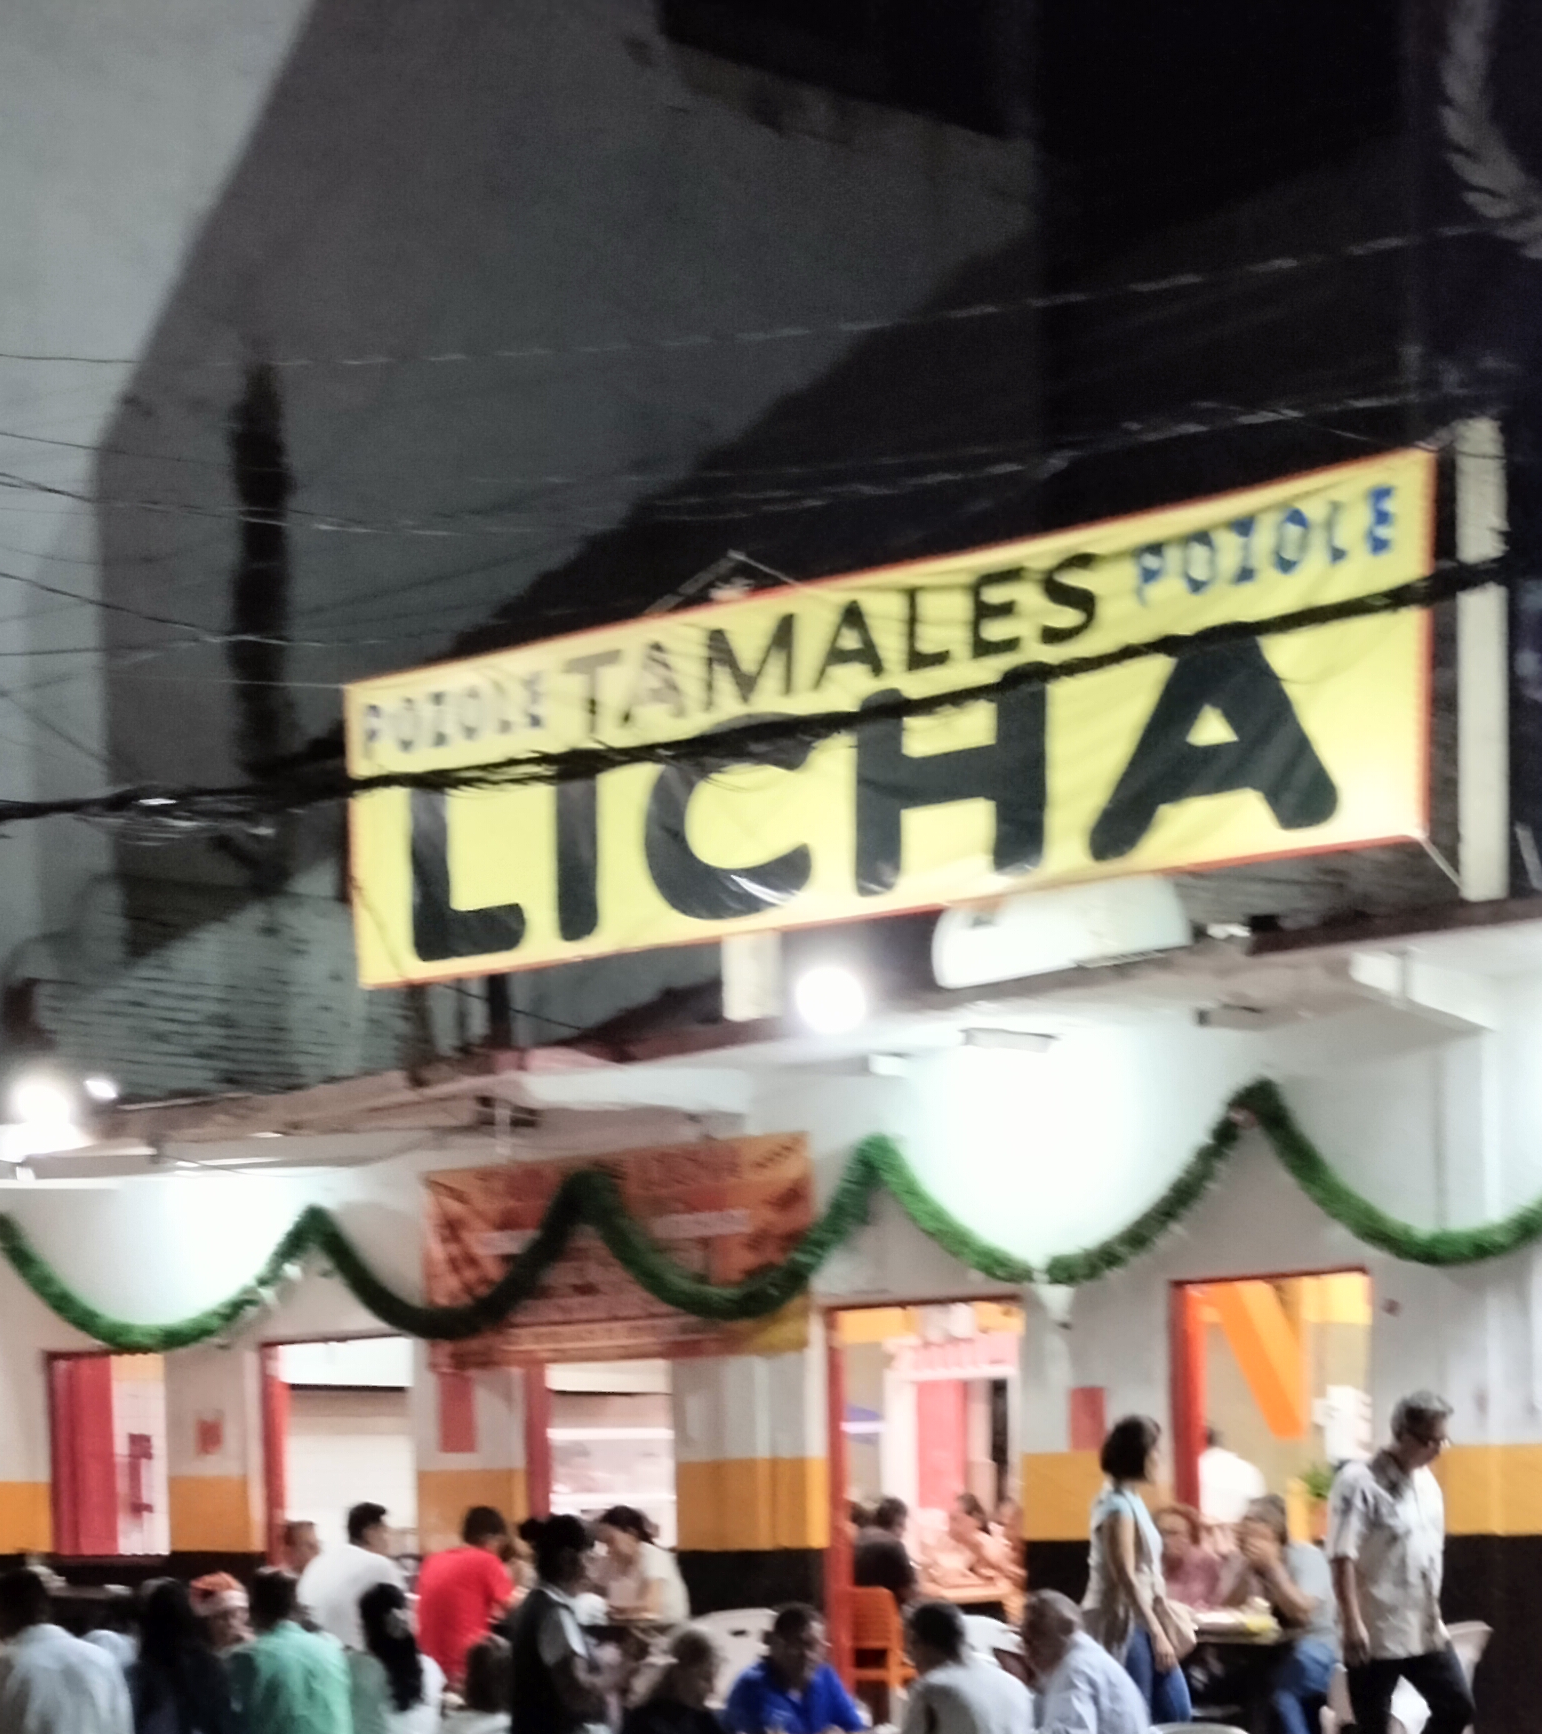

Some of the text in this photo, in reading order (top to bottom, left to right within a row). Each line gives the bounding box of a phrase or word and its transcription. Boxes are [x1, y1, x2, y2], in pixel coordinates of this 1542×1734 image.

[363, 484, 1396, 760] POZOLE TAMALES POZOLE
[408, 632, 1339, 964] LICHA
